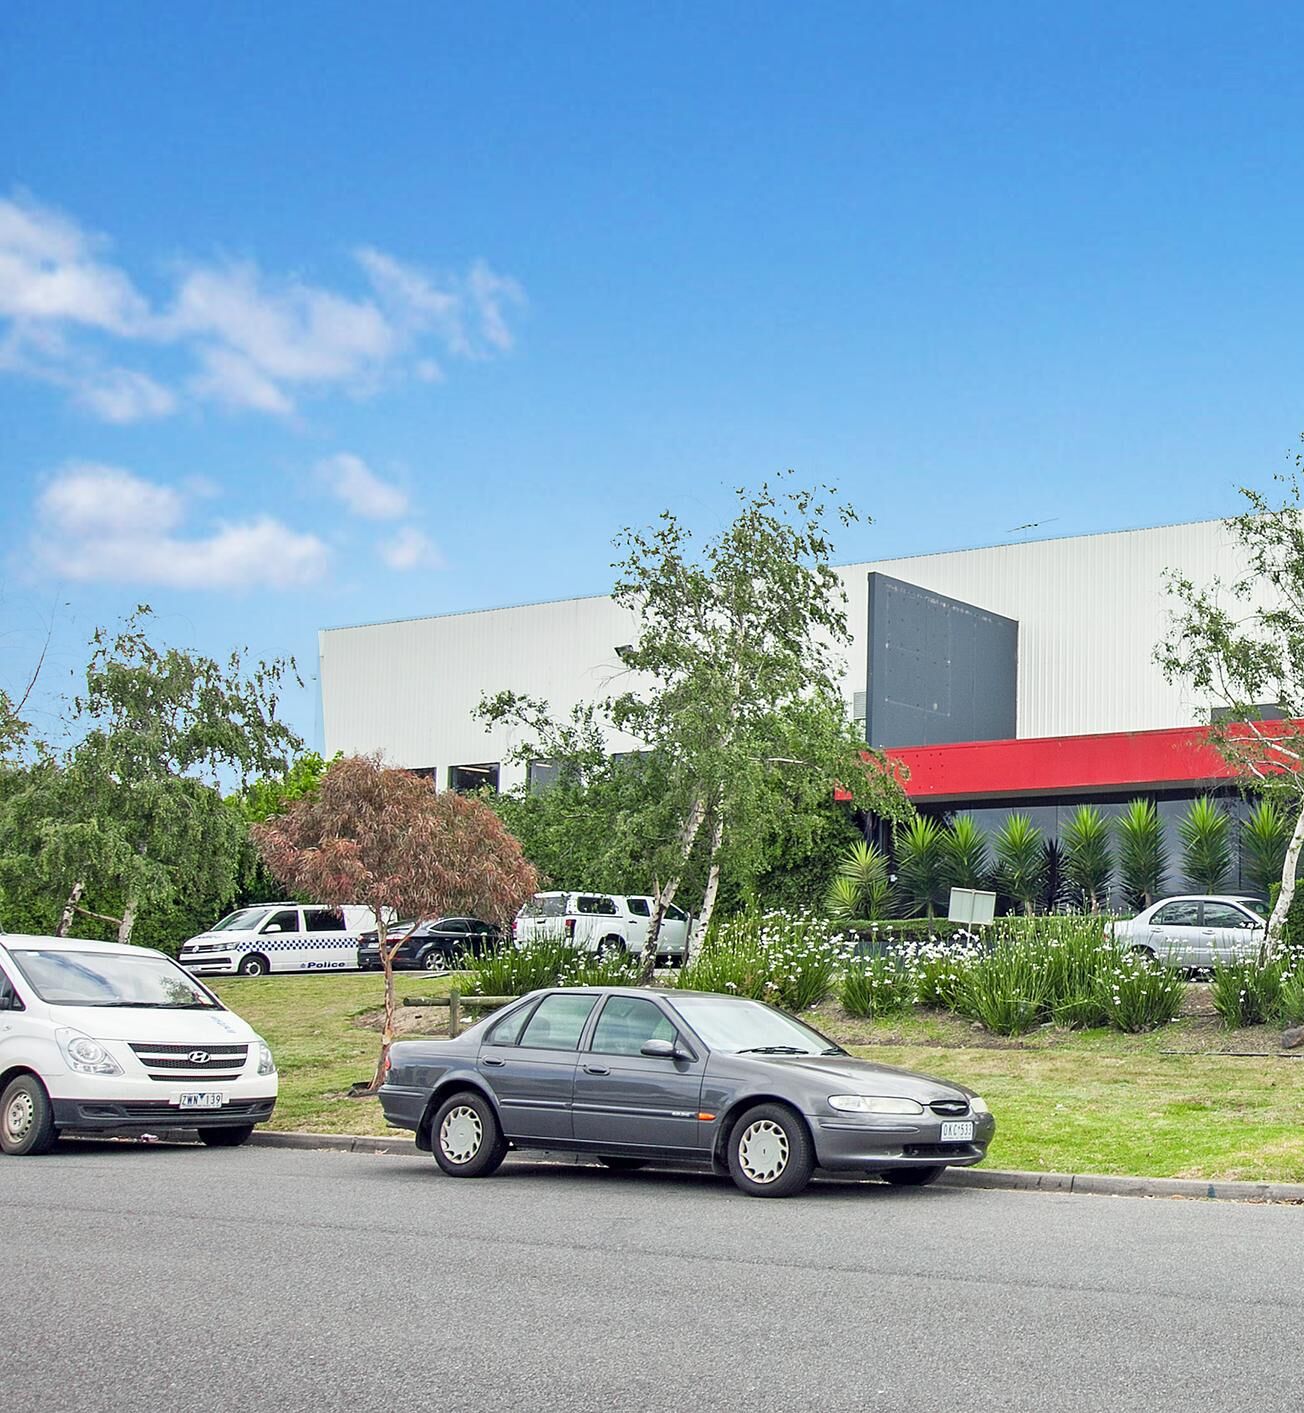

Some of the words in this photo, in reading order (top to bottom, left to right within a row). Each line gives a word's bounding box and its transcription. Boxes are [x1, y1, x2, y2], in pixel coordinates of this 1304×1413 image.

[307, 961, 346, 969] Police
[182, 1095, 199, 1106] ZWN
[206, 1095, 221, 1105] 139
